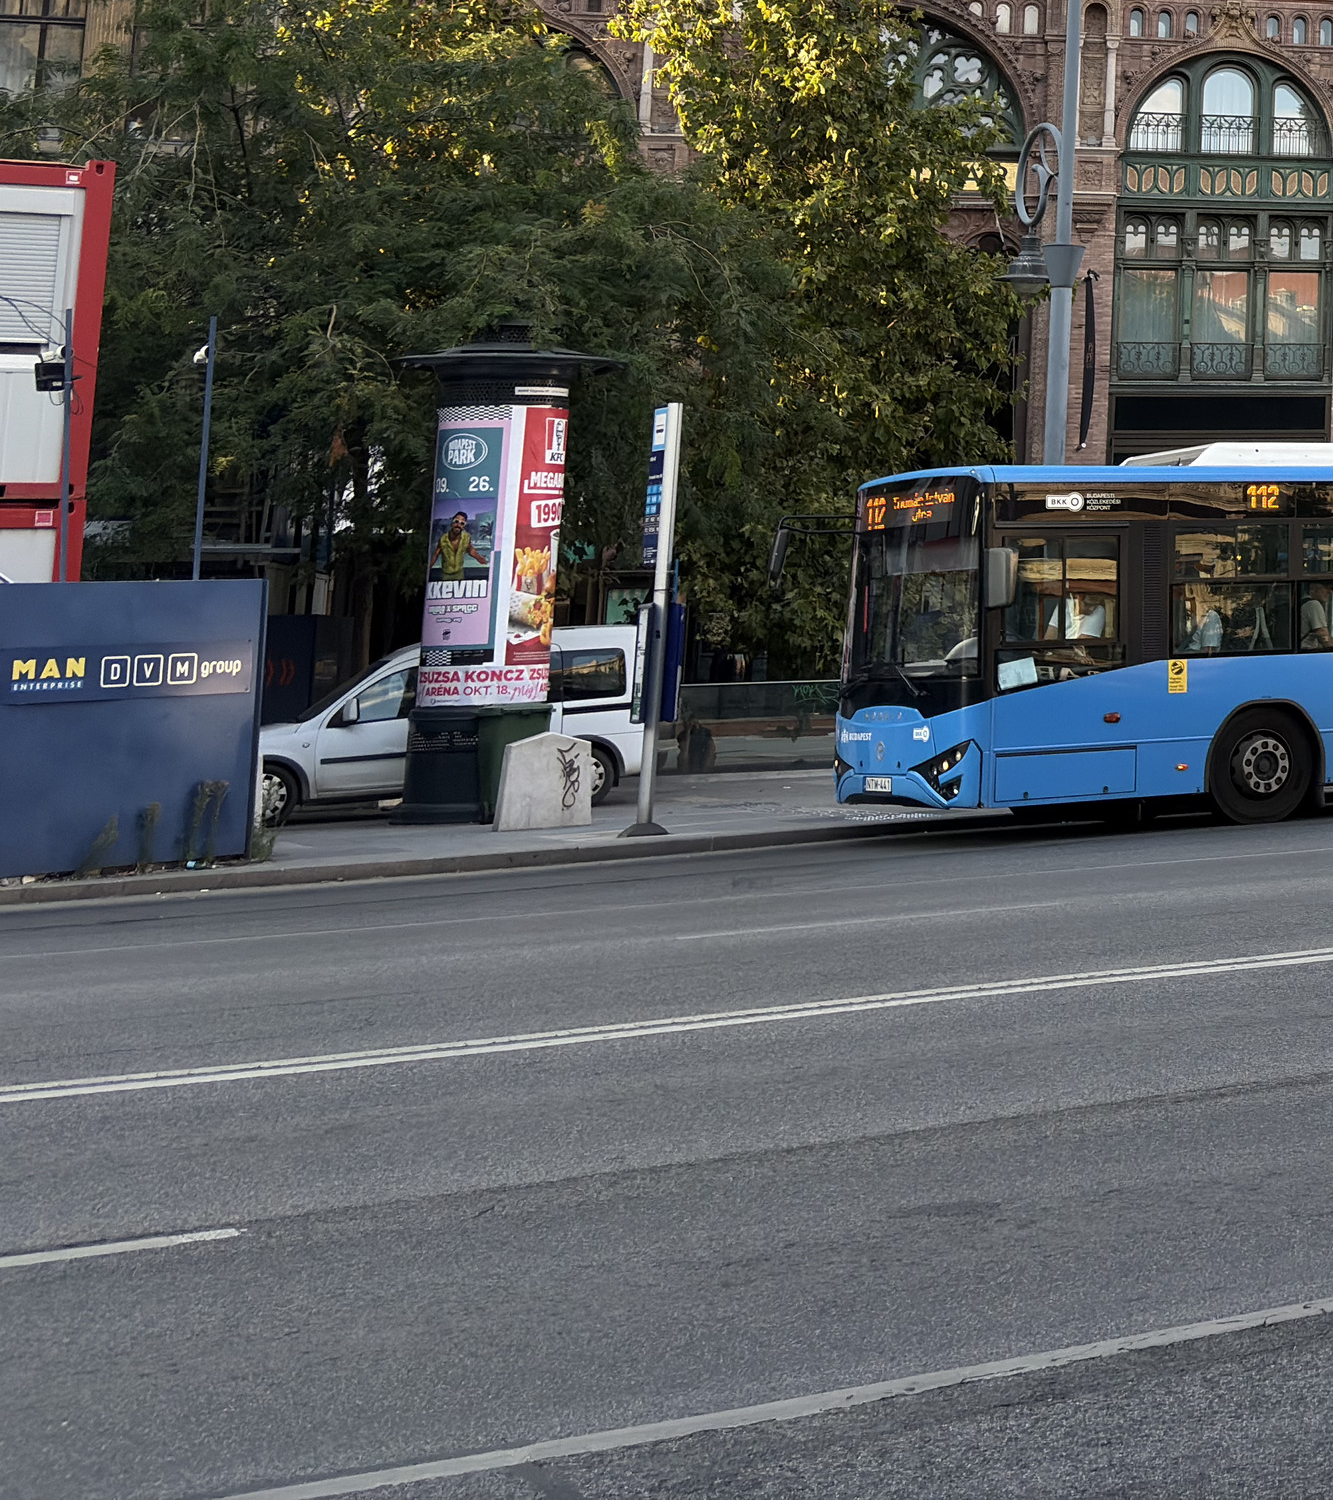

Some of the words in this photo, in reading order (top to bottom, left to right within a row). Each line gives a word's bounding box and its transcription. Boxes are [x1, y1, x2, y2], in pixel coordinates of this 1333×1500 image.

[448, 438, 476, 451] BUDAPEST
[447, 449, 476, 465] PARK
[469, 475, 494, 492] 26.
[1246, 484, 1279, 509] 112
[11, 657, 86, 681] MAN
[200, 659, 242, 678] group
[419, 670, 461, 684] ZSUZSA
[464, 668, 525, 683] KONCZ
[13, 680, 83, 691] ENTERPRISE
[425, 684, 460, 697] ARÉNA
[463, 685, 493, 696] OKT.
[496, 684, 511, 696] 18.
[849, 732, 872, 741] BUDAPEST
